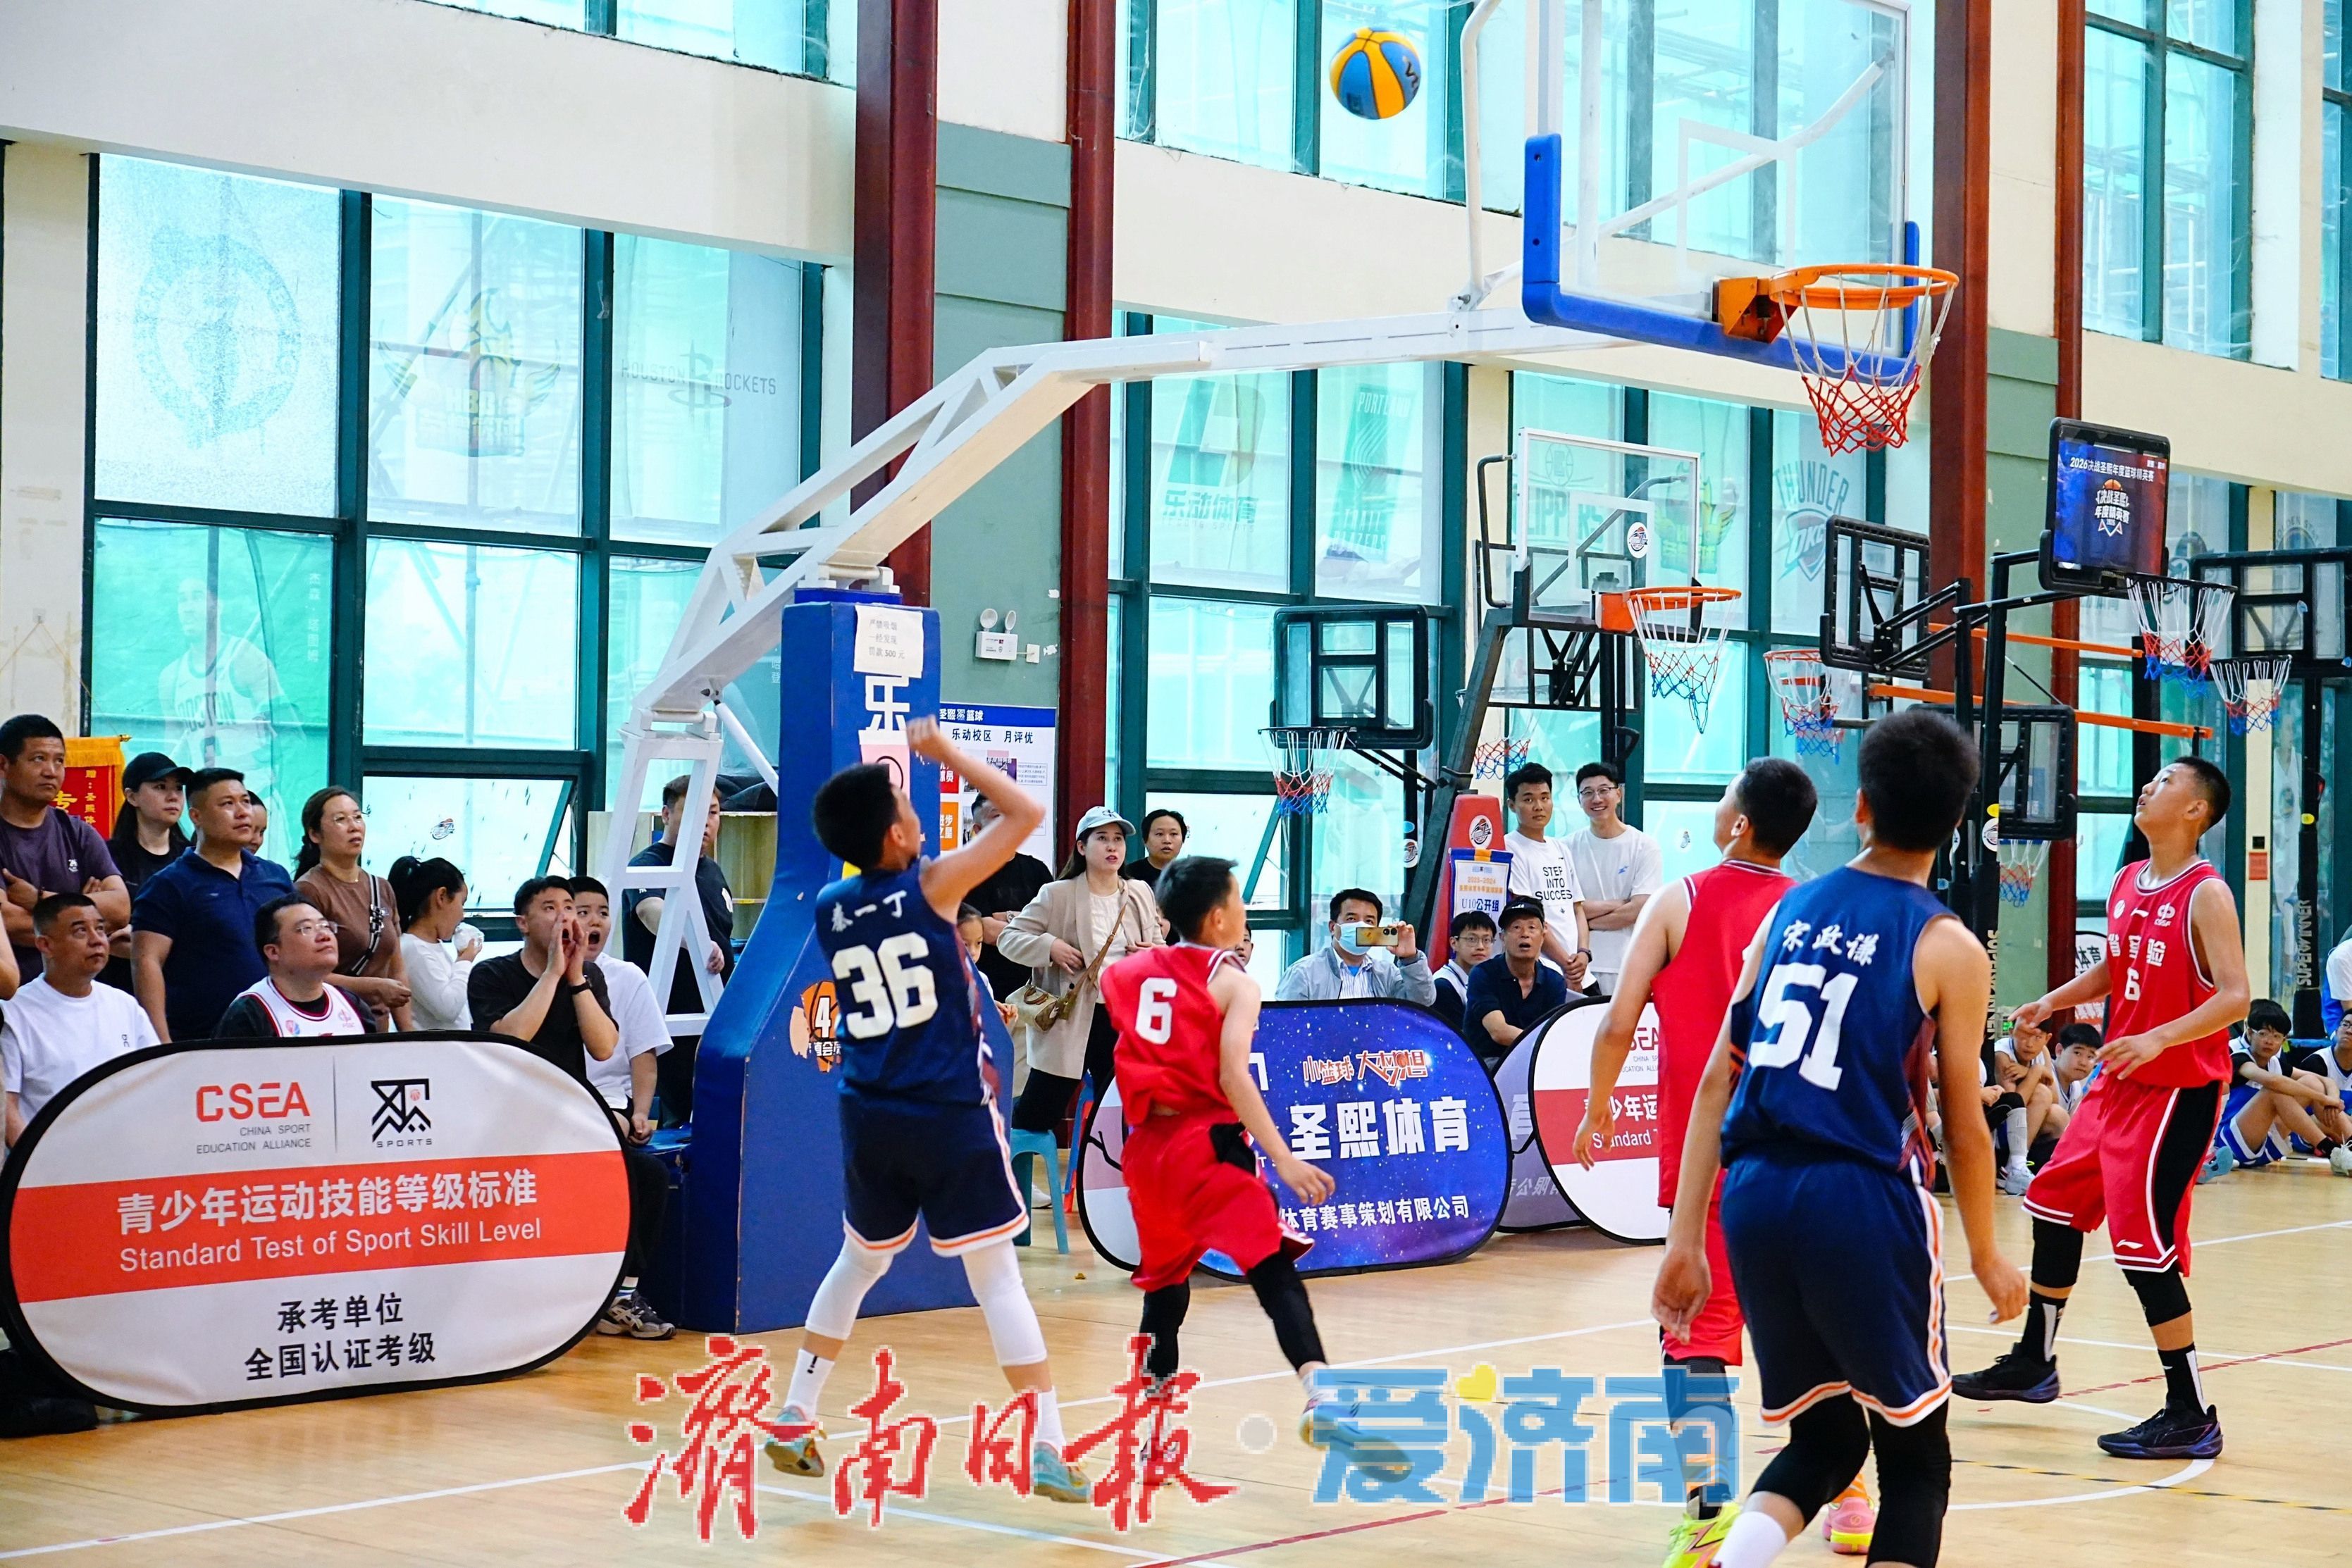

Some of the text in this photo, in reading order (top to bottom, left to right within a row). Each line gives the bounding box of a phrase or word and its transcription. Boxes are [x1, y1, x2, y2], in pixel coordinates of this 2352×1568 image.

[715, 373, 776, 394] ROCKETS
[1774, 460, 1850, 516] THUNDER
[865, 676, 910, 731] 乐
[952, 728, 1034, 744] 乐动校区 月评优
[1543, 866, 1563, 877] STEP
[1547, 878, 1566, 889] INTO
[1461, 898, 1499, 912] U10公开组
[2296, 900, 2313, 986] SUPERWINNER
[831, 932, 939, 1040] 36
[2124, 967, 2141, 1001] 6
[815, 997, 831, 1038] 4
[1134, 977, 1177, 1045] 6
[1748, 962, 1859, 1091] 51
[1303, 1055, 1354, 1085] 小篮球
[196, 1082, 311, 1123] CSEA
[197, 1138, 311, 1155] EDUCATION ALLIANCE
[240, 1124, 311, 1137] CHINA SPORT
[376, 1138, 433, 1148] SPORTS
[1289, 1095, 1469, 1161] 圣熙体育
[1592, 1129, 1652, 1149] Sandard
[117, 1169, 538, 1235] 青少年运动技能等级标准
[120, 1218, 541, 1272] Standard Test of Sport Skill Level
[277, 1292, 404, 1333] 承考单位
[245, 1332, 435, 1381] 全国认证考级
